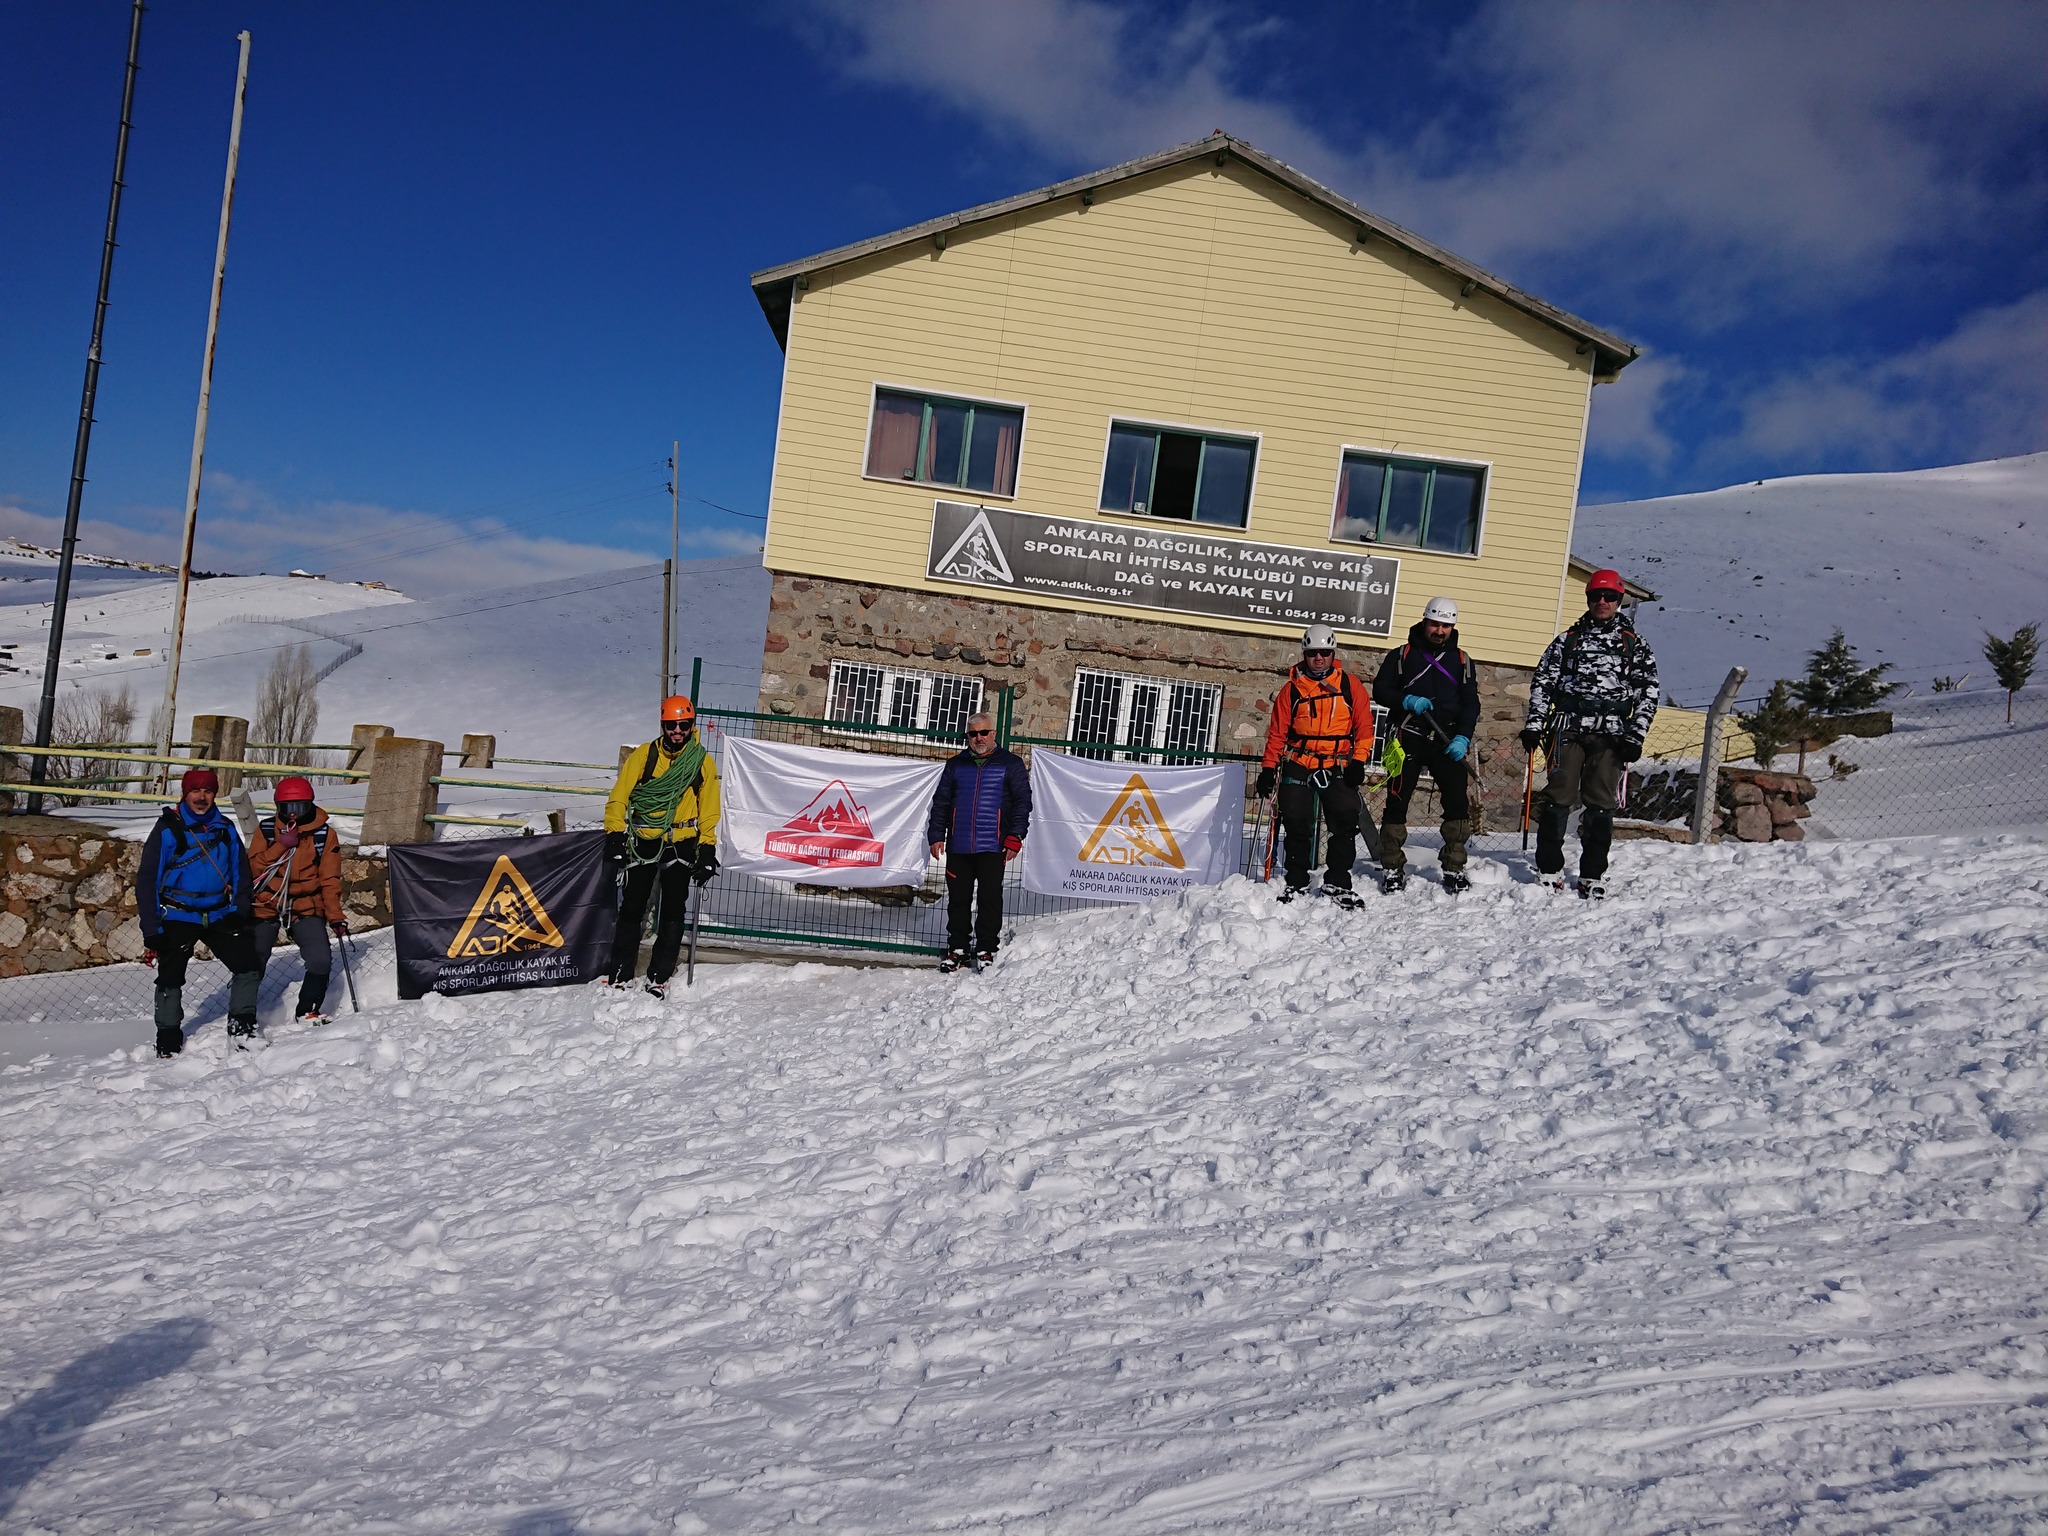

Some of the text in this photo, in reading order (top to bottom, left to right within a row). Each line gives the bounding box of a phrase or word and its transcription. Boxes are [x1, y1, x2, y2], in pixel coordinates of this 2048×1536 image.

[1044, 525, 1374, 577] ANKARA DAĞCILIK, KAYAK ve KIŞ
[1024, 540, 1390, 596] SPORLARI İHTİSAS KULÜBÜ DERNEĞİ
[1024, 576, 1133, 597] www.adkk.org.tr
[1115, 571, 1294, 603] DAĞ ve KAYAK EVİ
[1248, 604, 1273, 615] TEL
[1285, 608, 1316, 620] 0541
[1320, 613, 1346, 623] 229
[1350, 616, 1366, 626] 14
[1369, 617, 1387, 627] 47
[768, 840, 797, 854] TÜRKİYE
[832, 848, 880, 863] FEDERASYONU
[1062, 881, 1077, 891] KIŞ
[1079, 882, 1123, 895] SPORLARI
[1126, 885, 1160, 897] İHTİSAS
[1069, 869, 1105, 881] ANKARA
[1107, 871, 1148, 884] DAĞCILIK
[1150, 876, 1179, 886] KAYAK
[438, 955, 572, 977] ANKARA DAĞCILIK KAYAK VE
[449, 975, 498, 989] SPORLARI
[501, 972, 538, 983] İHTİSAS
[540, 966, 579, 980] KULÜBÜ
